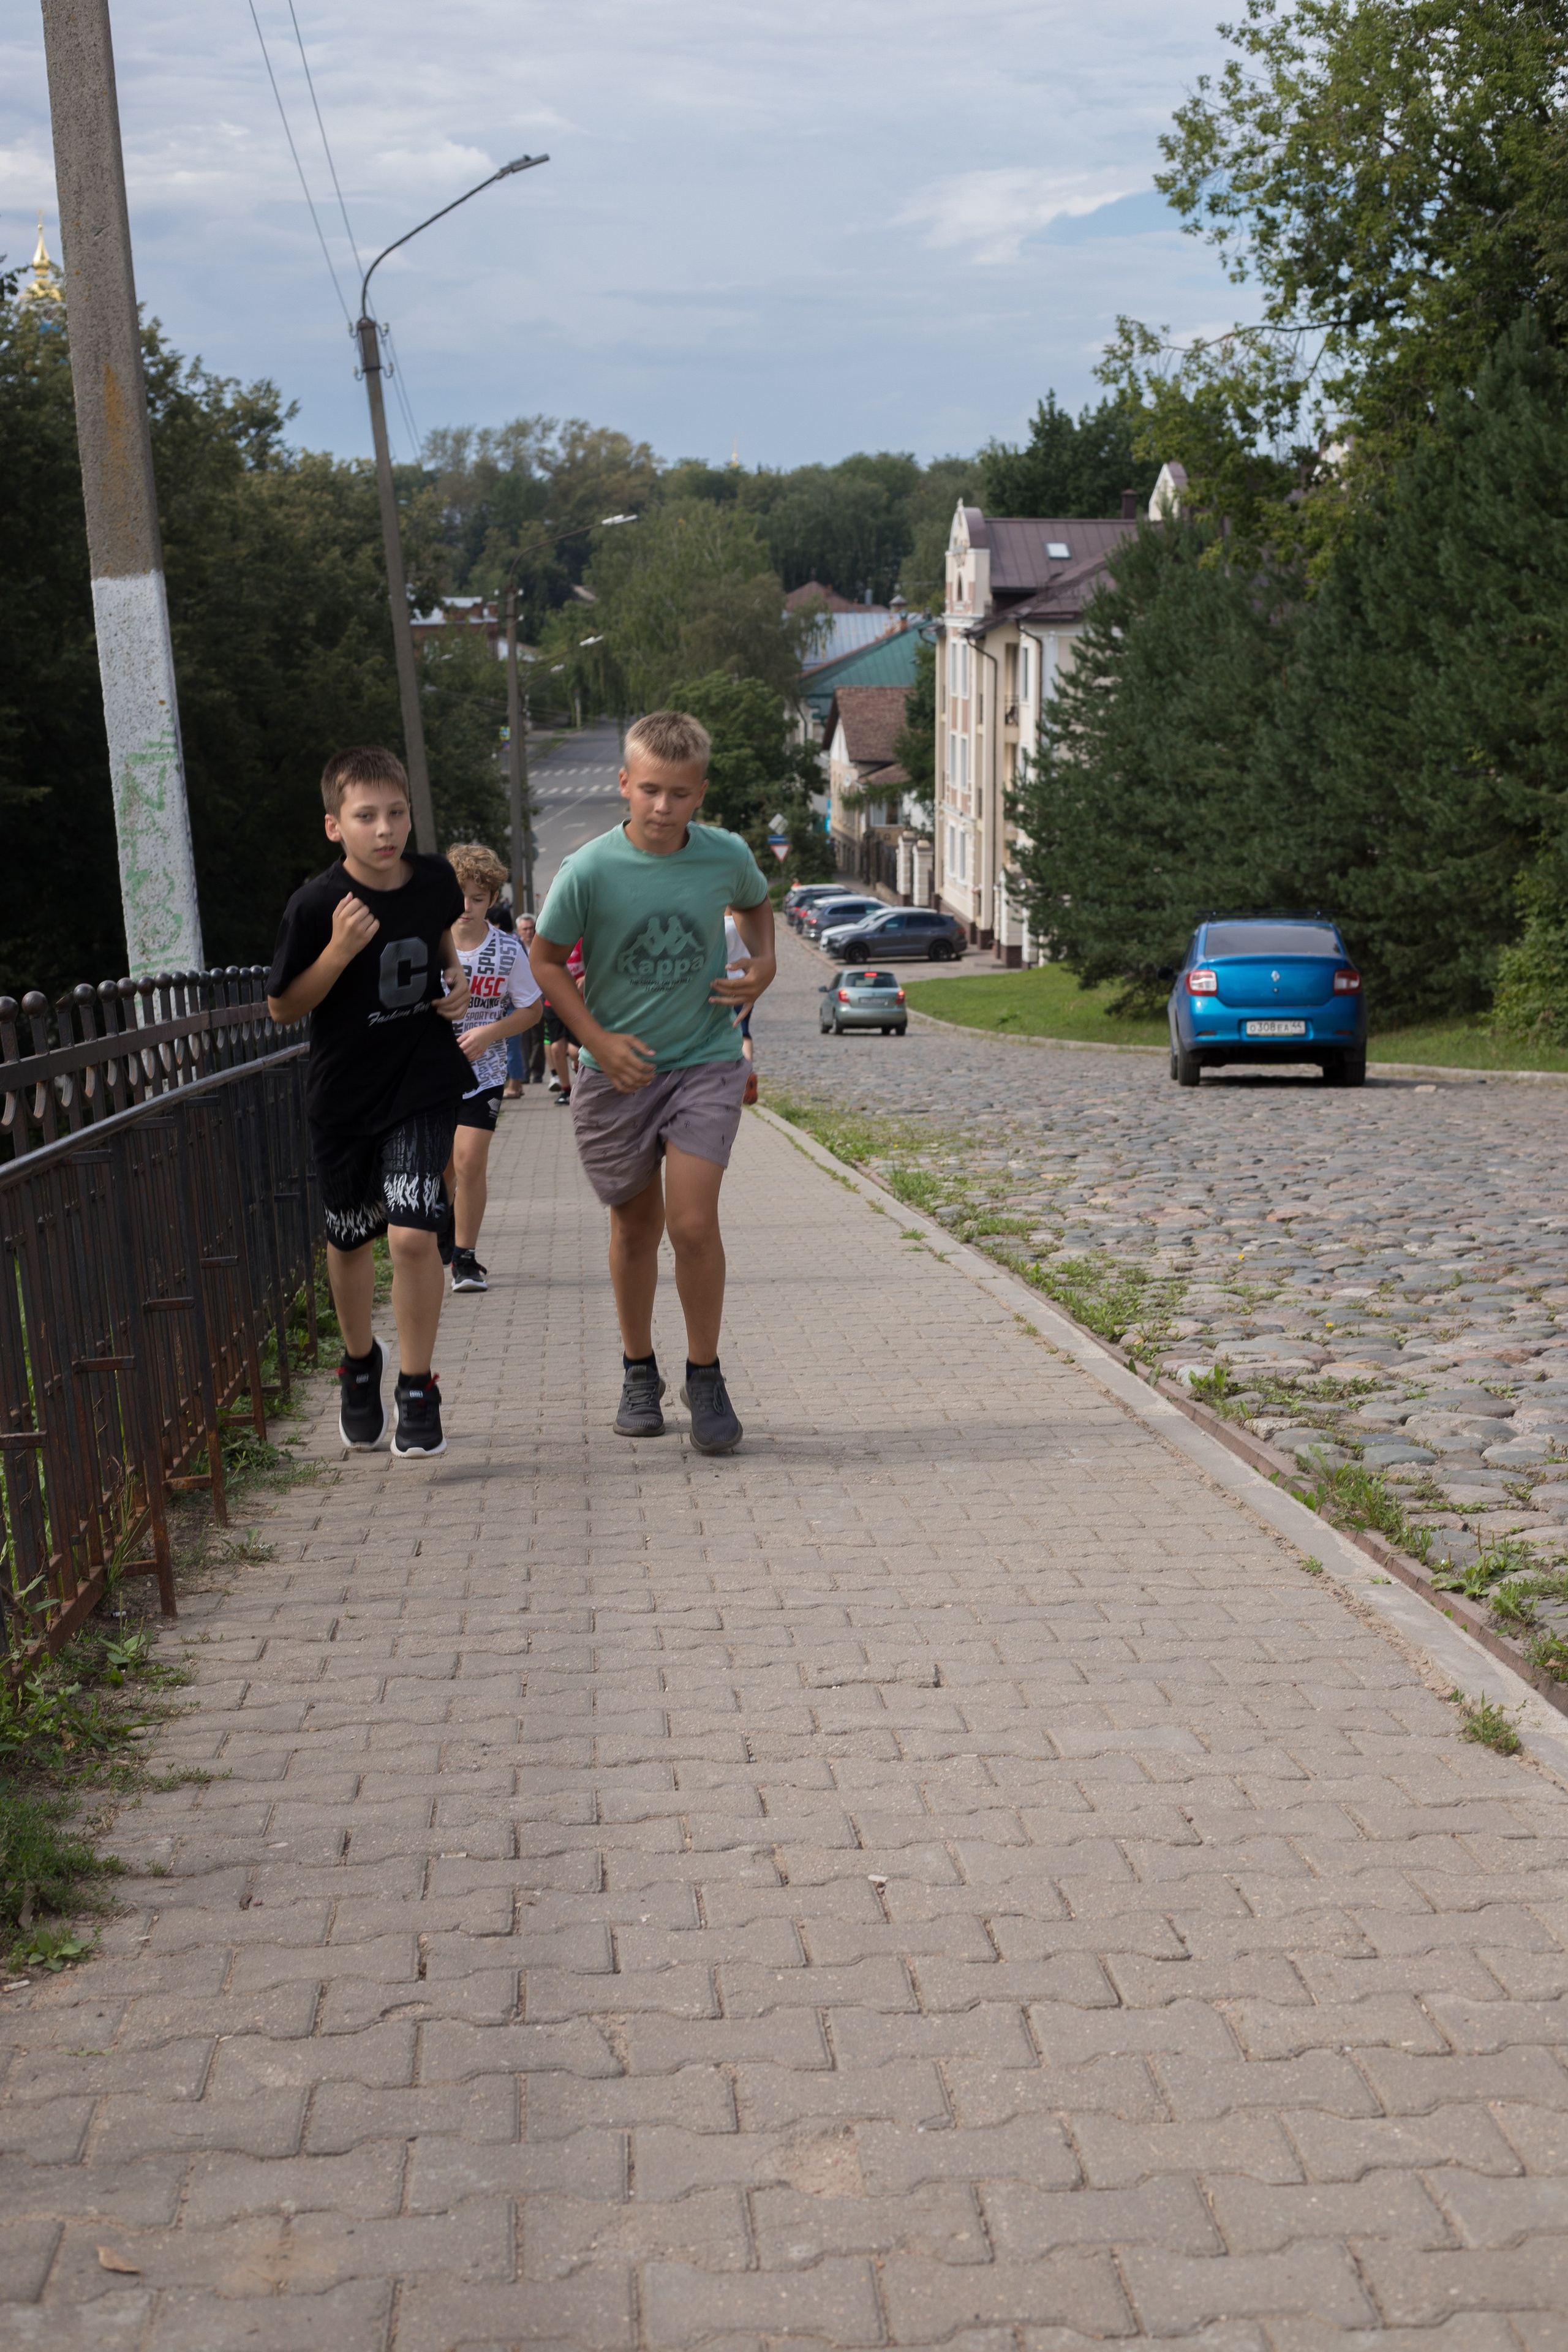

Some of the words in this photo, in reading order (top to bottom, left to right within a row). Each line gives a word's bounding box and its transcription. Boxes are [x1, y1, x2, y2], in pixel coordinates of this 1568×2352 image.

[379, 937, 428, 1009] C
[617, 952, 705, 980] Kappa
[470, 976, 505, 997] KSC
[469, 997, 500, 1009] BOXING
[466, 1011, 489, 1022] SPORT
